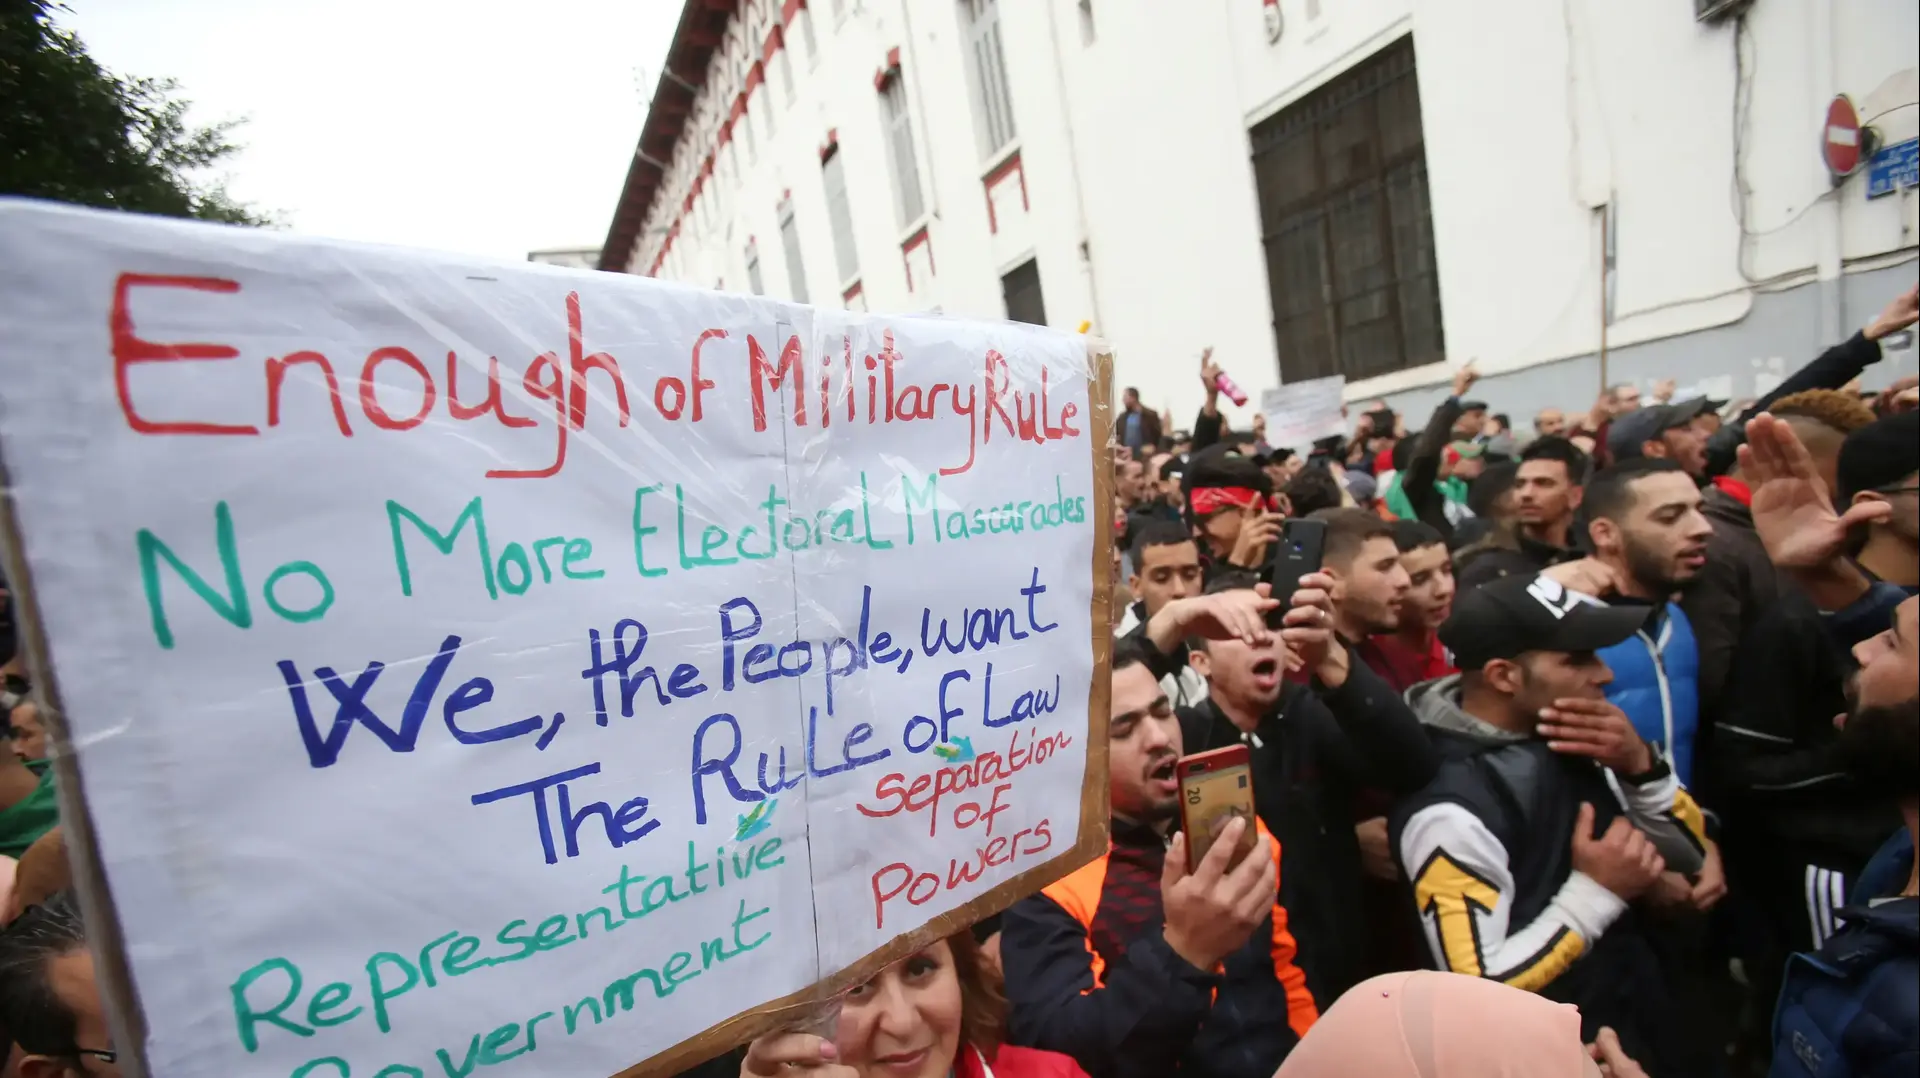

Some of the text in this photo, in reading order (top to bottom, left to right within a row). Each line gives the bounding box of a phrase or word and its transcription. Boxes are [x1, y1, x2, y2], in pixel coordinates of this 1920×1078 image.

[110, 272, 1081, 479] Enough of Military Rule
[136, 471, 1086, 650] No More Electoral Mascarades
[276, 566, 1060, 769] We, the People, want
[471, 662, 1060, 865] The Rule of Law
[1186, 786, 1202, 806] 20
[229, 838, 787, 1055] Representative
[871, 818, 1052, 929] Powers
[290, 899, 772, 1078] vernment
